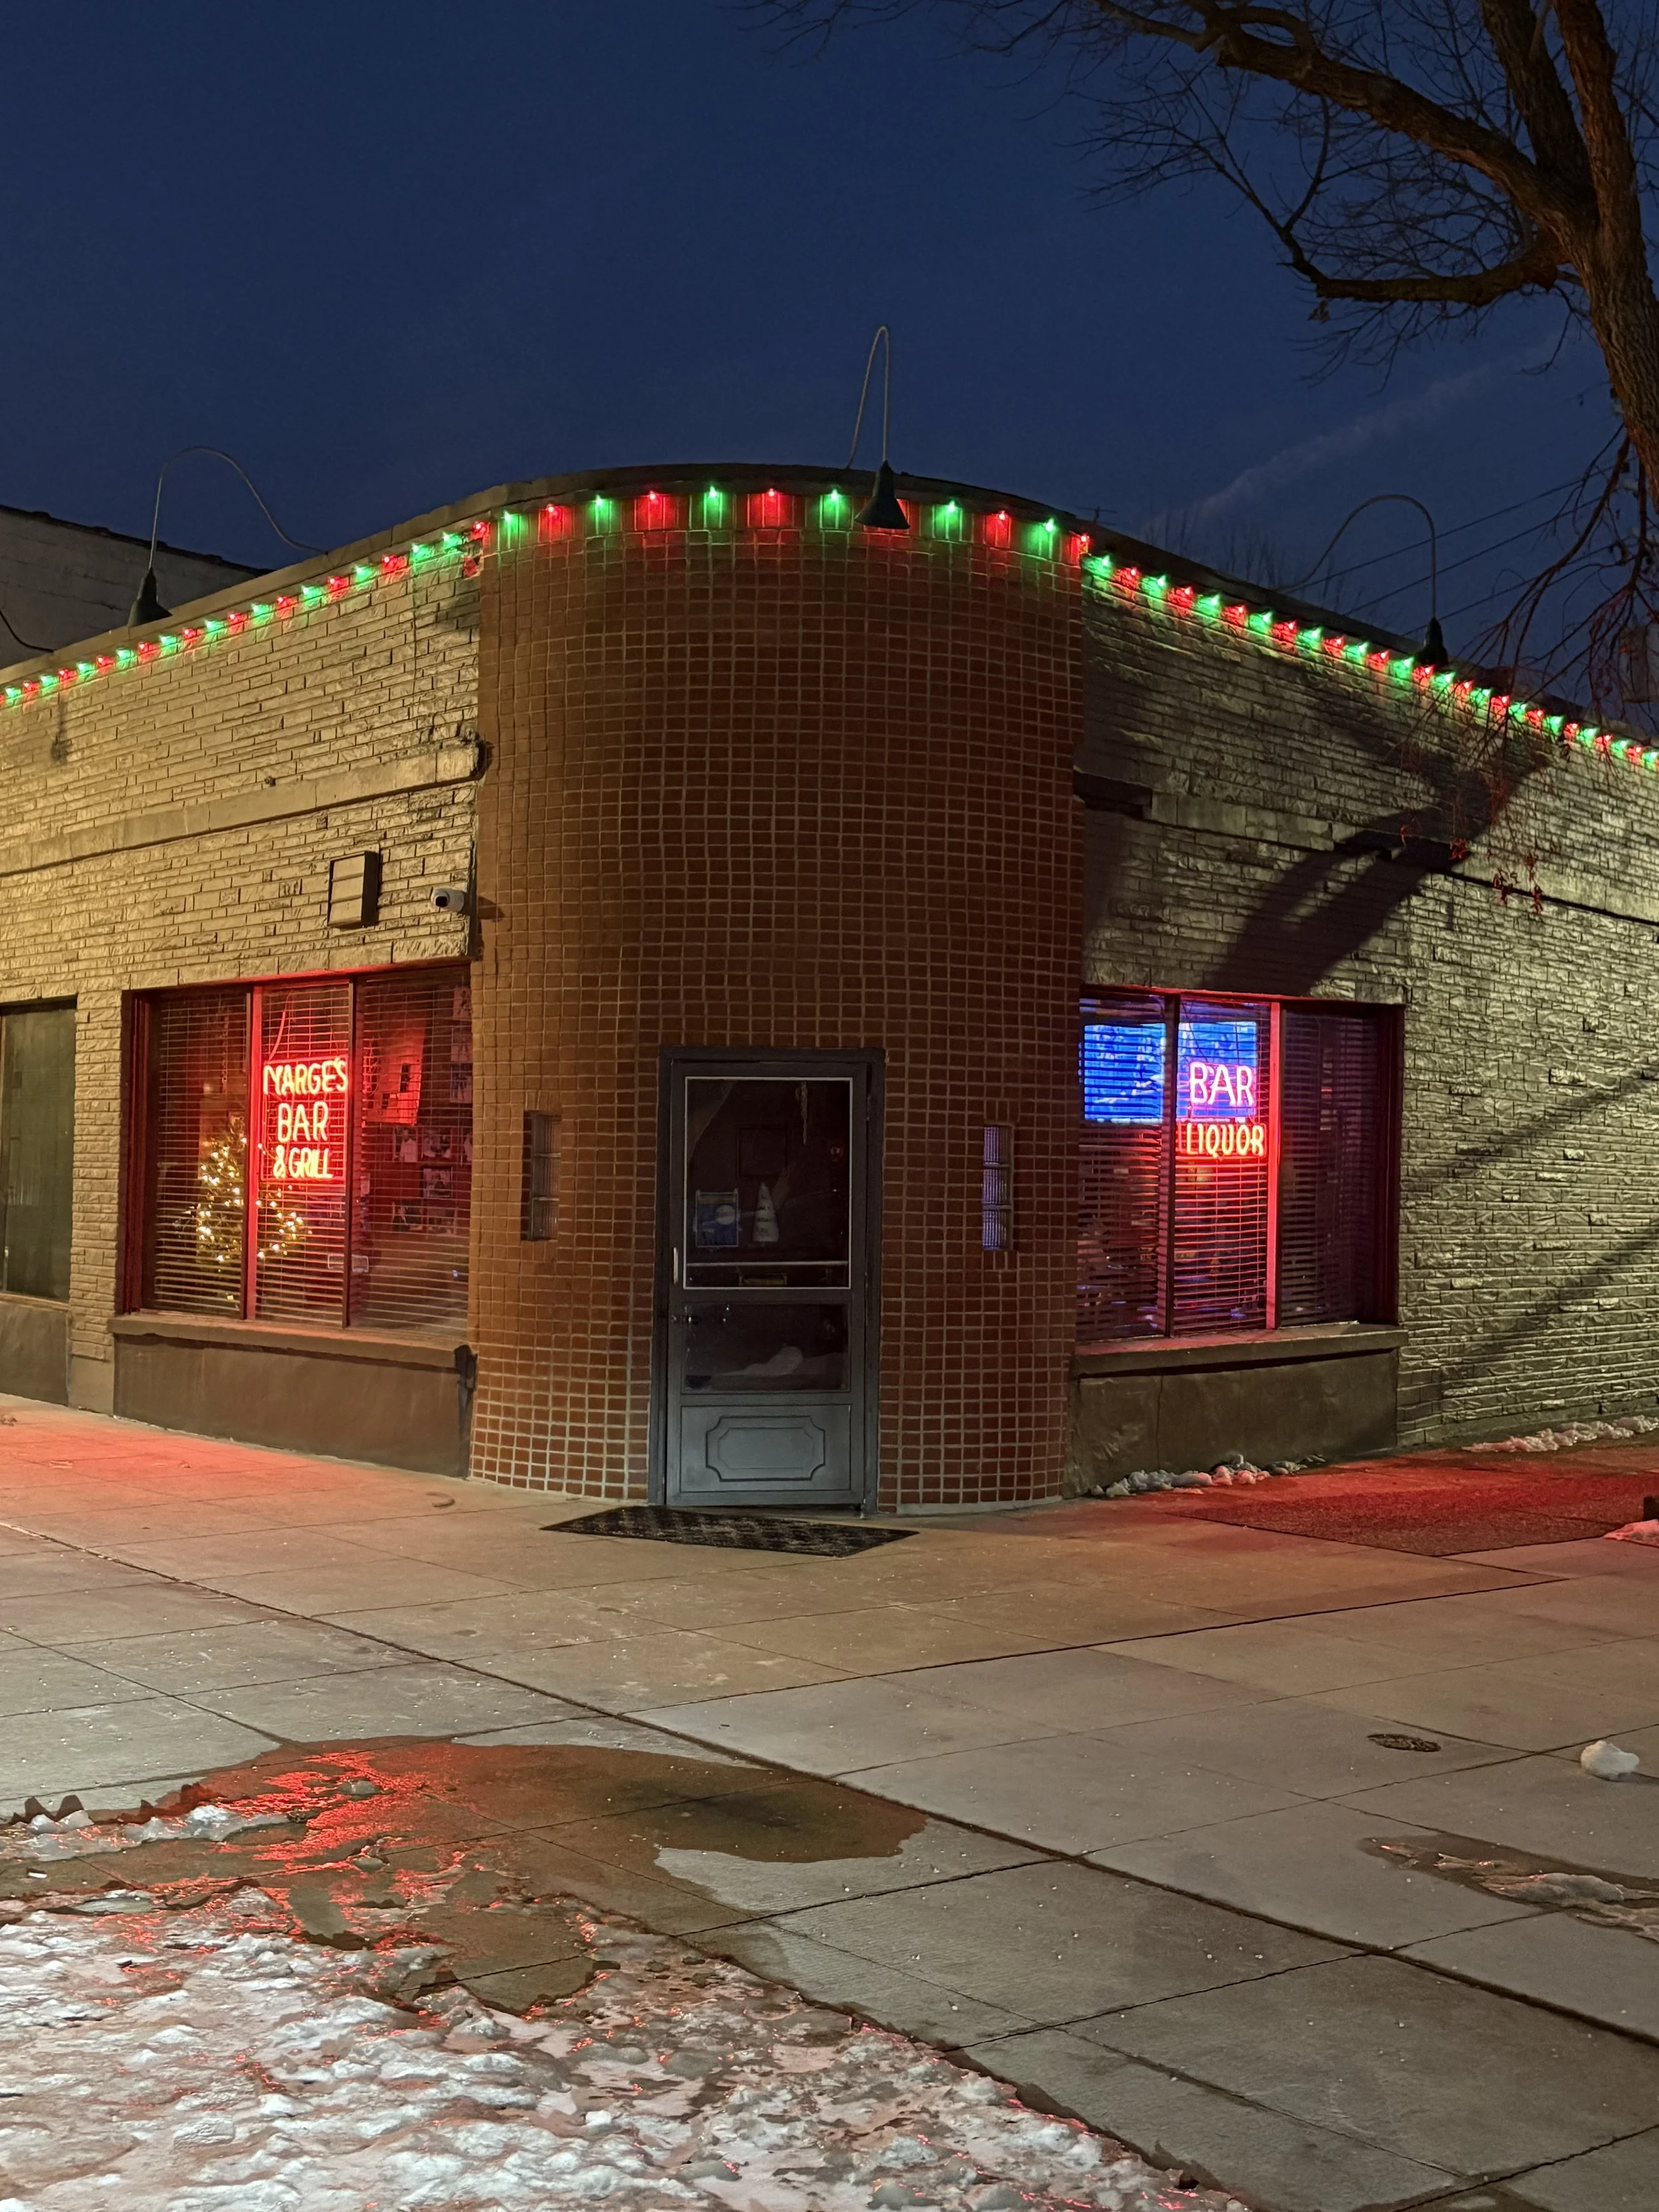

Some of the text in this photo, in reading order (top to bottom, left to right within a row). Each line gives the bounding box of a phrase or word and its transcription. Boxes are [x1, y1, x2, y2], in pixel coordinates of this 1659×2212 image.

[1190, 1062, 1254, 1106] BAR
[277, 1101, 328, 1142] BAR
[1187, 1123, 1263, 1157] LIQUOR
